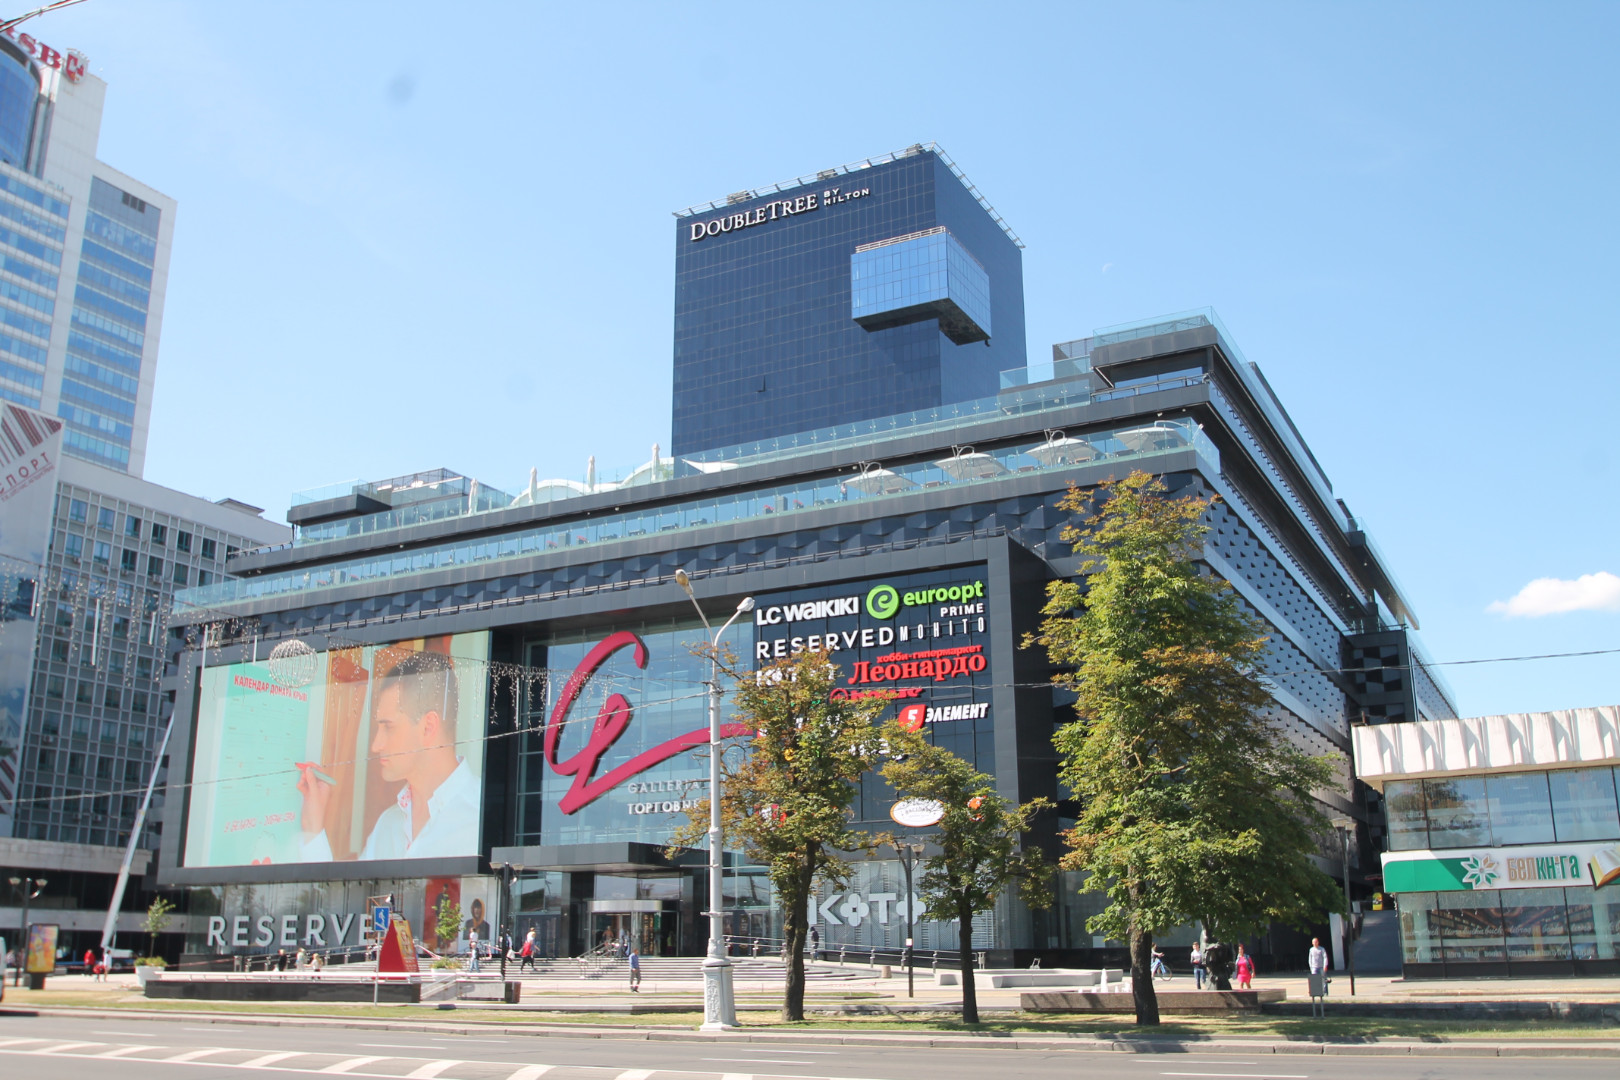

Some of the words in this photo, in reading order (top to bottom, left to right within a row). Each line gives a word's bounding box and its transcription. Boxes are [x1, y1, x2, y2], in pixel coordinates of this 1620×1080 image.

[823, 188, 840, 198] BY
[823, 188, 870, 206] HILTON
[903, 580, 984, 606] euroopt
[756, 607, 781, 626] LC
[940, 602, 984, 618] PRIME
[900, 616, 985, 642] MOHITO
[756, 626, 894, 660] RESERVED
[876, 644, 983, 664] хобби-гипермаркет
[847, 653, 987, 685] Леонардо
[234, 674, 269, 693] КАЛЕНДАР
[925, 702, 989, 724] ЭЛЕМЕНТ
[627, 779, 700, 794] GALLERIA
[807, 891, 961, 927] KOTO
